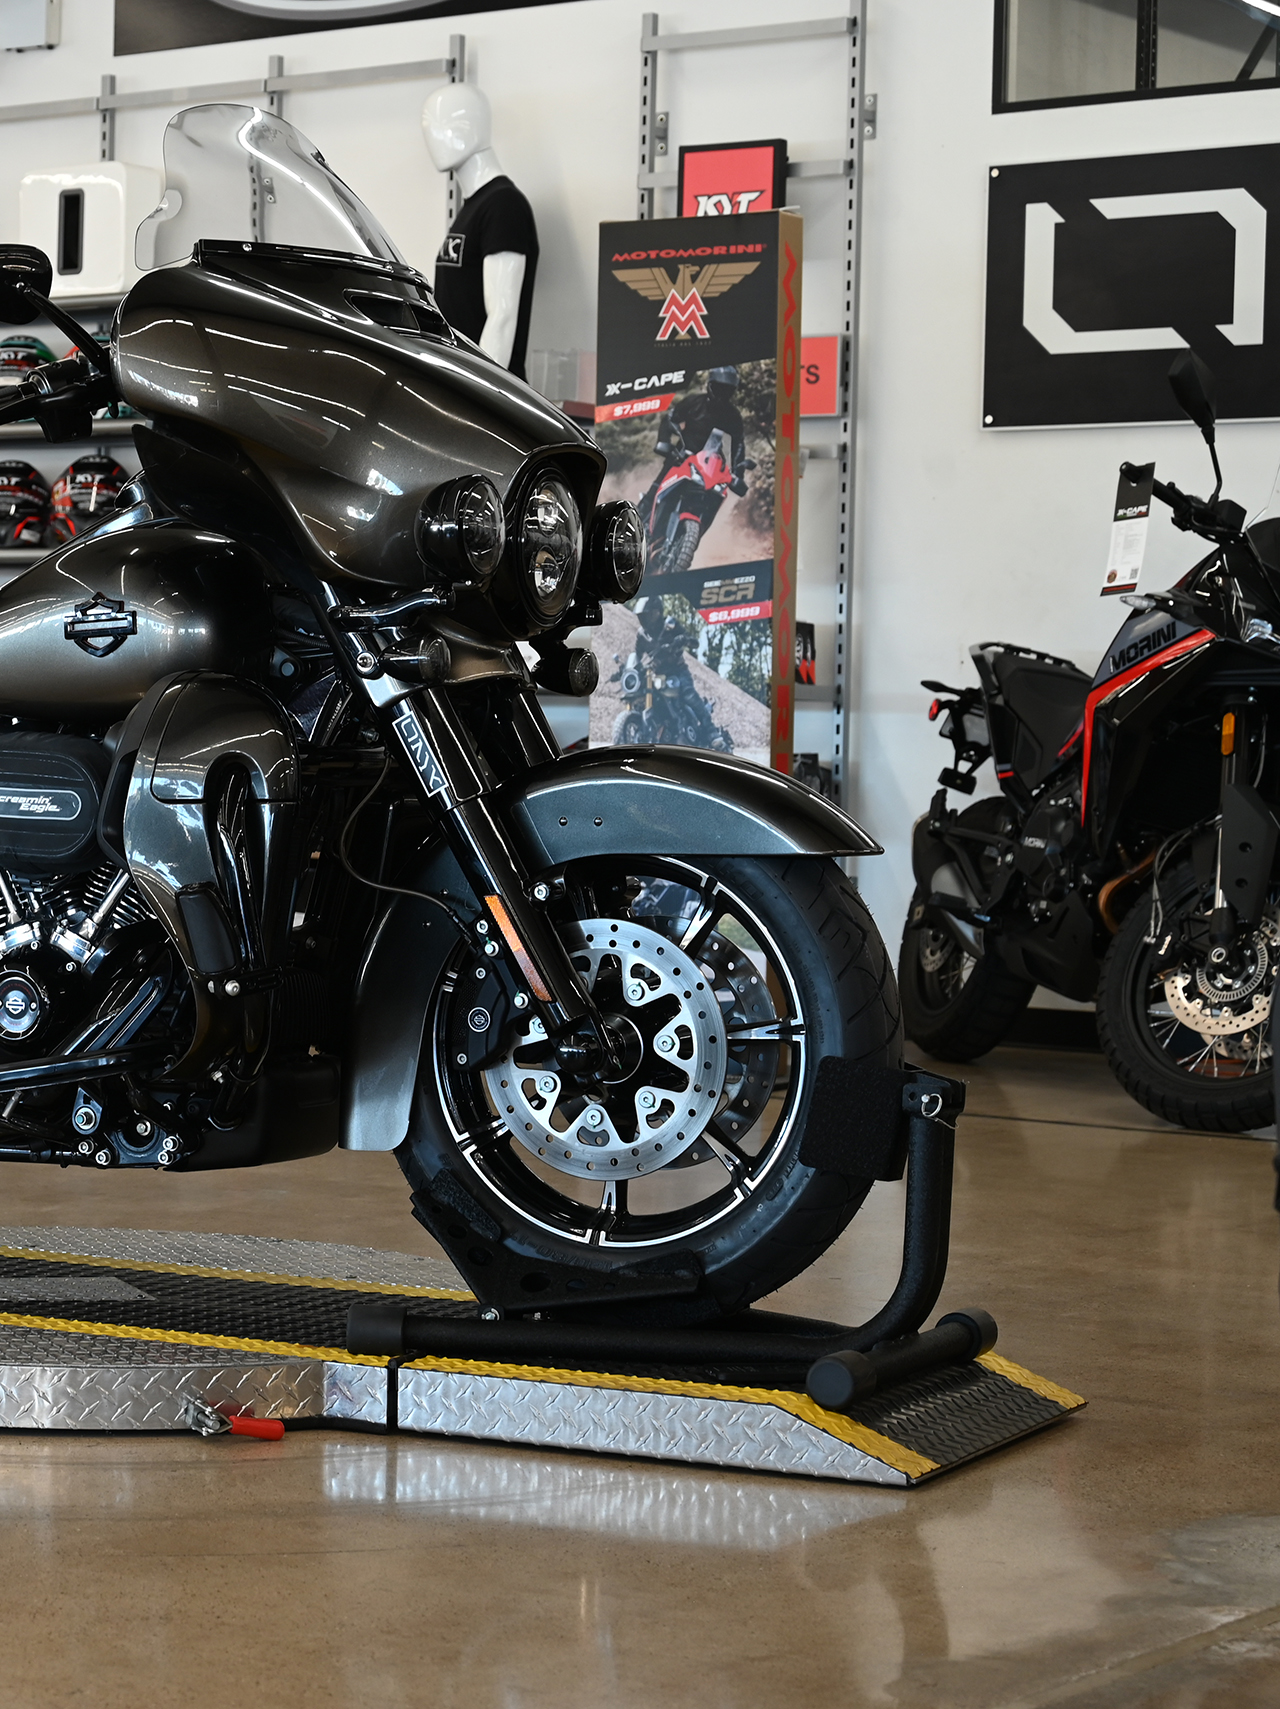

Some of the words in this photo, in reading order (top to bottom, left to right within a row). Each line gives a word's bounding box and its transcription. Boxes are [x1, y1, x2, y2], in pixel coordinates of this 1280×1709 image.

[611, 243, 763, 262] MOTOMORINI
[605, 370, 686, 397] X-CAPE
[700, 583, 755, 605] SCR
[1109, 621, 1176, 674] MORINI
[19, 802, 61, 813] Eagle
